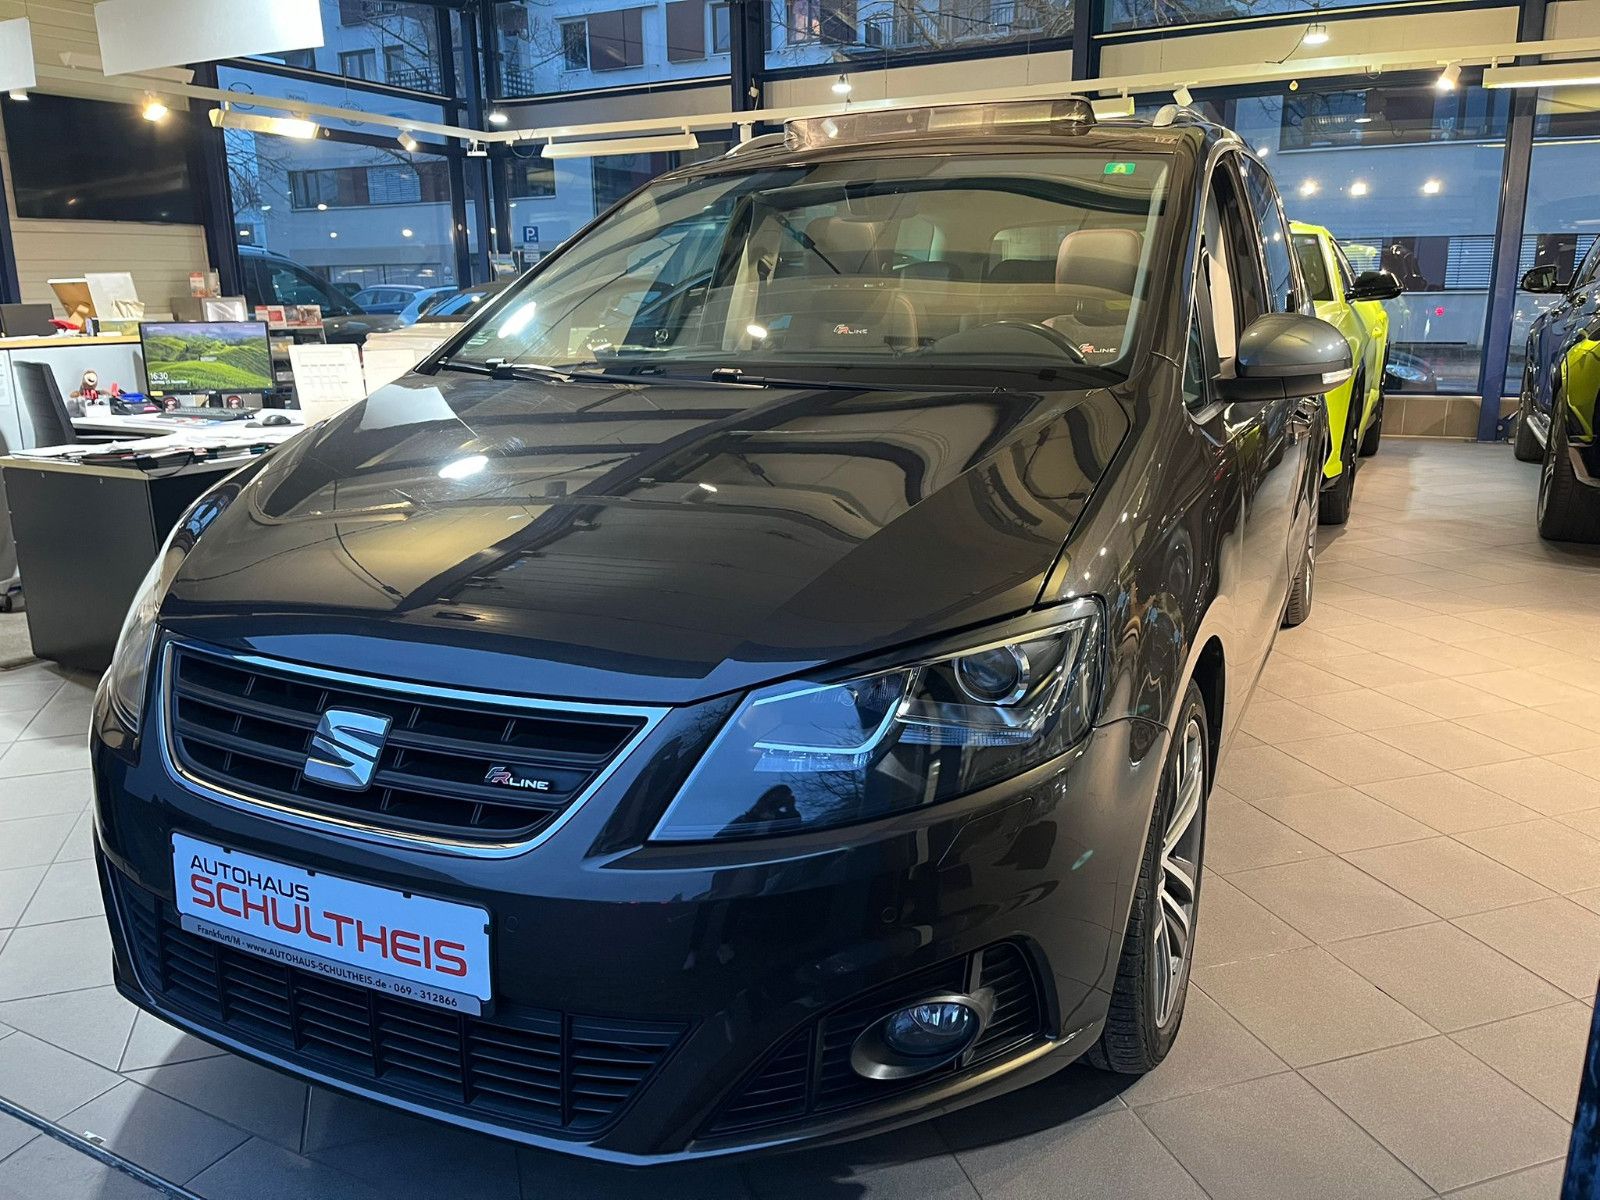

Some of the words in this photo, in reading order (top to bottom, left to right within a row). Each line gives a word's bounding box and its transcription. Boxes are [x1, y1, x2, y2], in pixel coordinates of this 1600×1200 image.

[526, 227, 536, 241] P
[190, 854, 310, 903] AUTOHAUS
[190, 873, 468, 977] SCHULTHEIS
[197, 924, 241, 946] Frankfurt/M
[246, 941, 387, 988] www.AUTOHAUS-SCHULTHEIS.de
[394, 983, 412, 996] 069
[420, 990, 458, 1008] 312866
